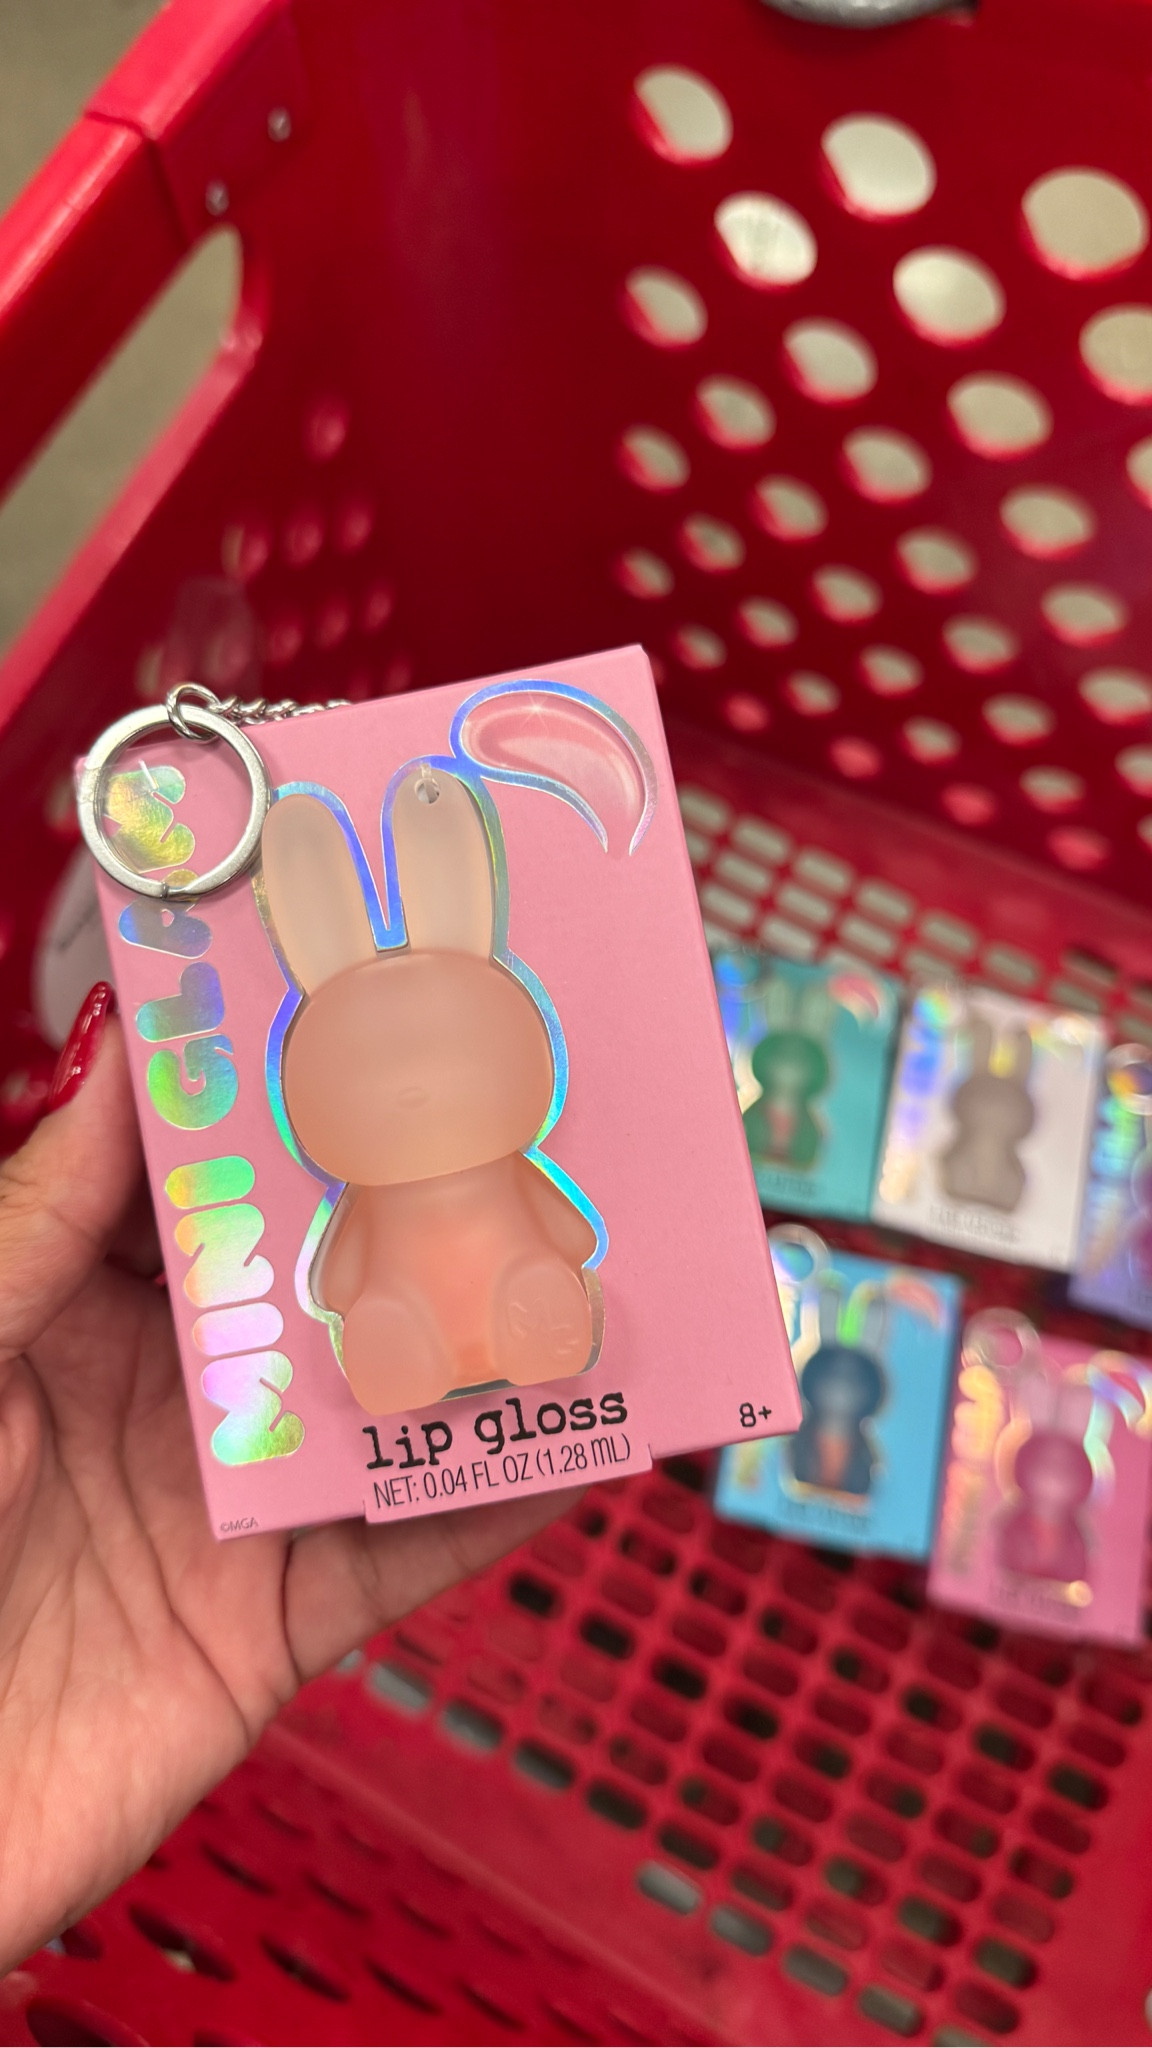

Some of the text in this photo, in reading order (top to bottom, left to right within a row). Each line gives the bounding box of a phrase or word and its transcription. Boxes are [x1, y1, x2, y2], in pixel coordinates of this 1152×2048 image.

[165, 1154, 300, 1467] MINI
[362, 1391, 628, 1470] lip gloss
[739, 1402, 772, 1428] 8+
[373, 1474, 420, 1509] NET:
[423, 1465, 468, 1500] 0.04
[471, 1459, 500, 1491] FL
[502, 1452, 534, 1484] OZ
[536, 1441, 588, 1477] (1.28
